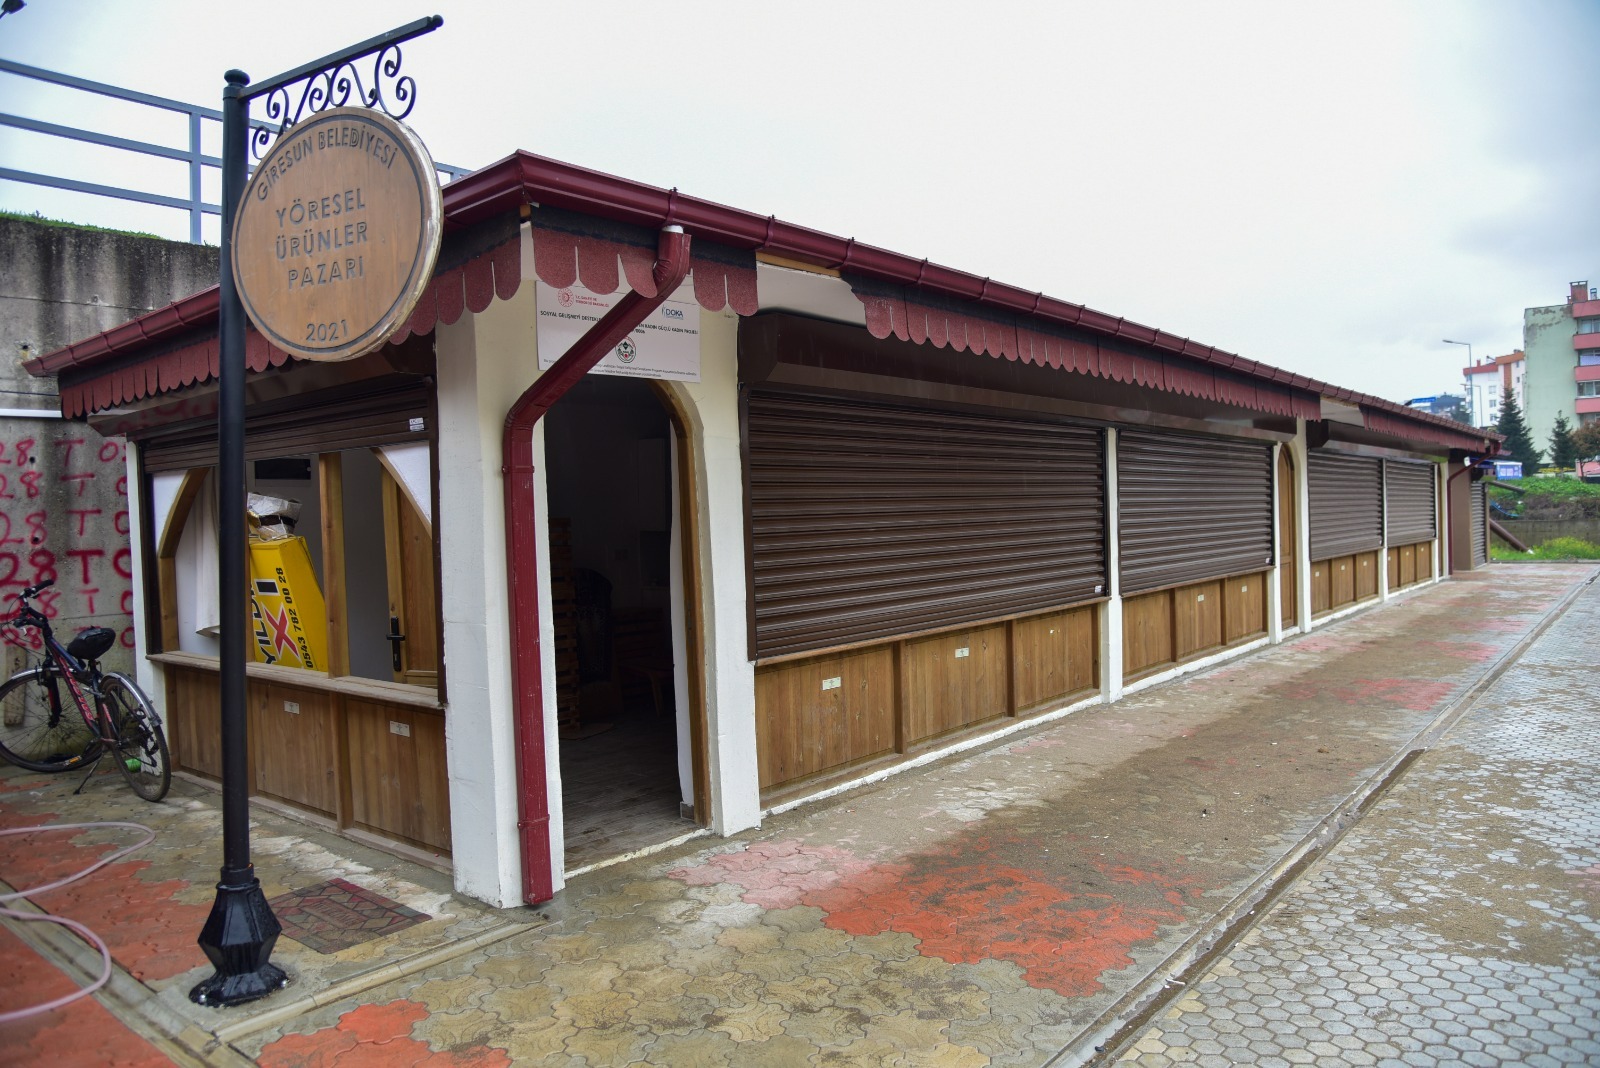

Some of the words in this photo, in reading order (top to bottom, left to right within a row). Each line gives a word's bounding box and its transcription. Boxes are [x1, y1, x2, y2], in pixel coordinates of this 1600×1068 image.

[257, 135, 314, 202] GİRESUN
[318, 124, 399, 170] BELEDİYESİ
[275, 187, 366, 229] YÖRESEL
[275, 221, 368, 260] ÜRÜNLER
[288, 255, 365, 290] PAZARI
[665, 308, 683, 317] DOKA
[306, 319, 348, 342] 2021
[275, 567, 287, 583] 28
[282, 587, 293, 604] 00
[288, 608, 302, 632] 782
[298, 636, 314, 668] 0543
